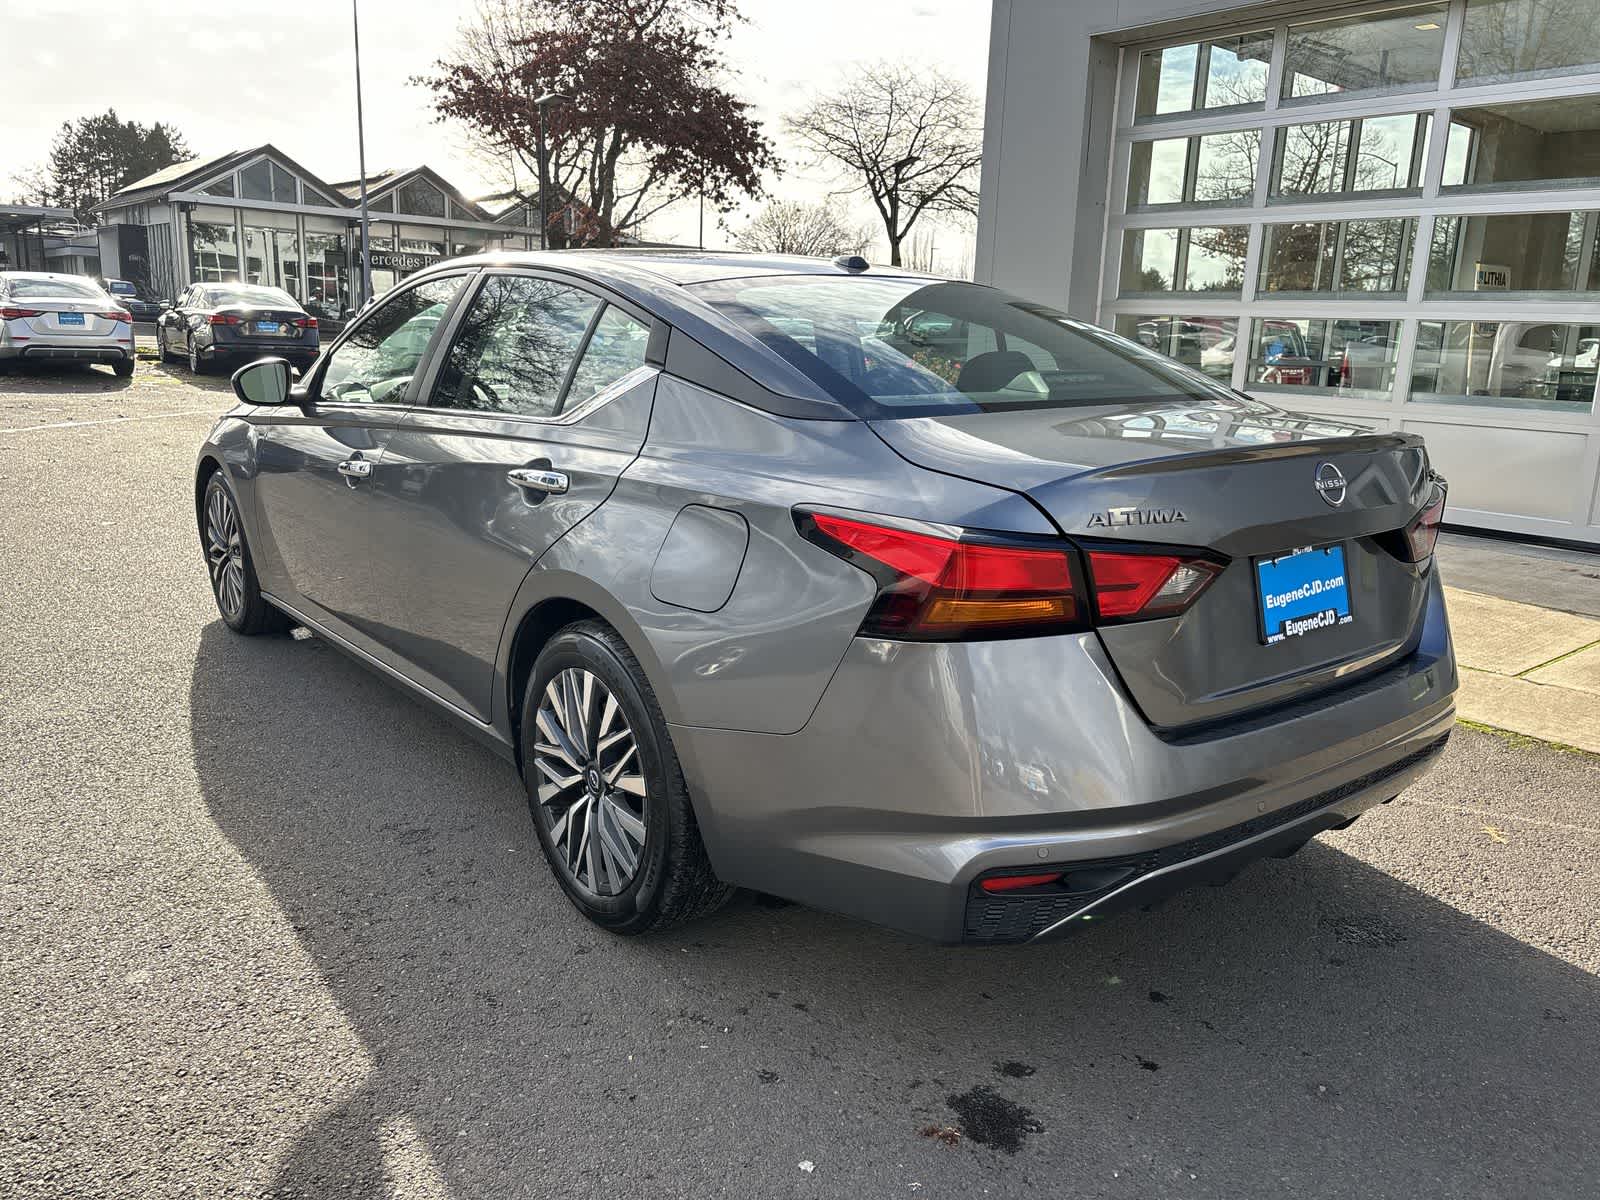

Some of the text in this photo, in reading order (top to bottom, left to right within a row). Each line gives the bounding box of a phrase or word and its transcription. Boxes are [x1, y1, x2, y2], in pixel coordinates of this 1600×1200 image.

[1484, 270, 1506, 287] LITHIA
[1086, 506, 1190, 528] ALTIMA
[1265, 575, 1345, 609] EugeneCJD.com
[1267, 609, 1353, 644] www. EugeneCJD .com
